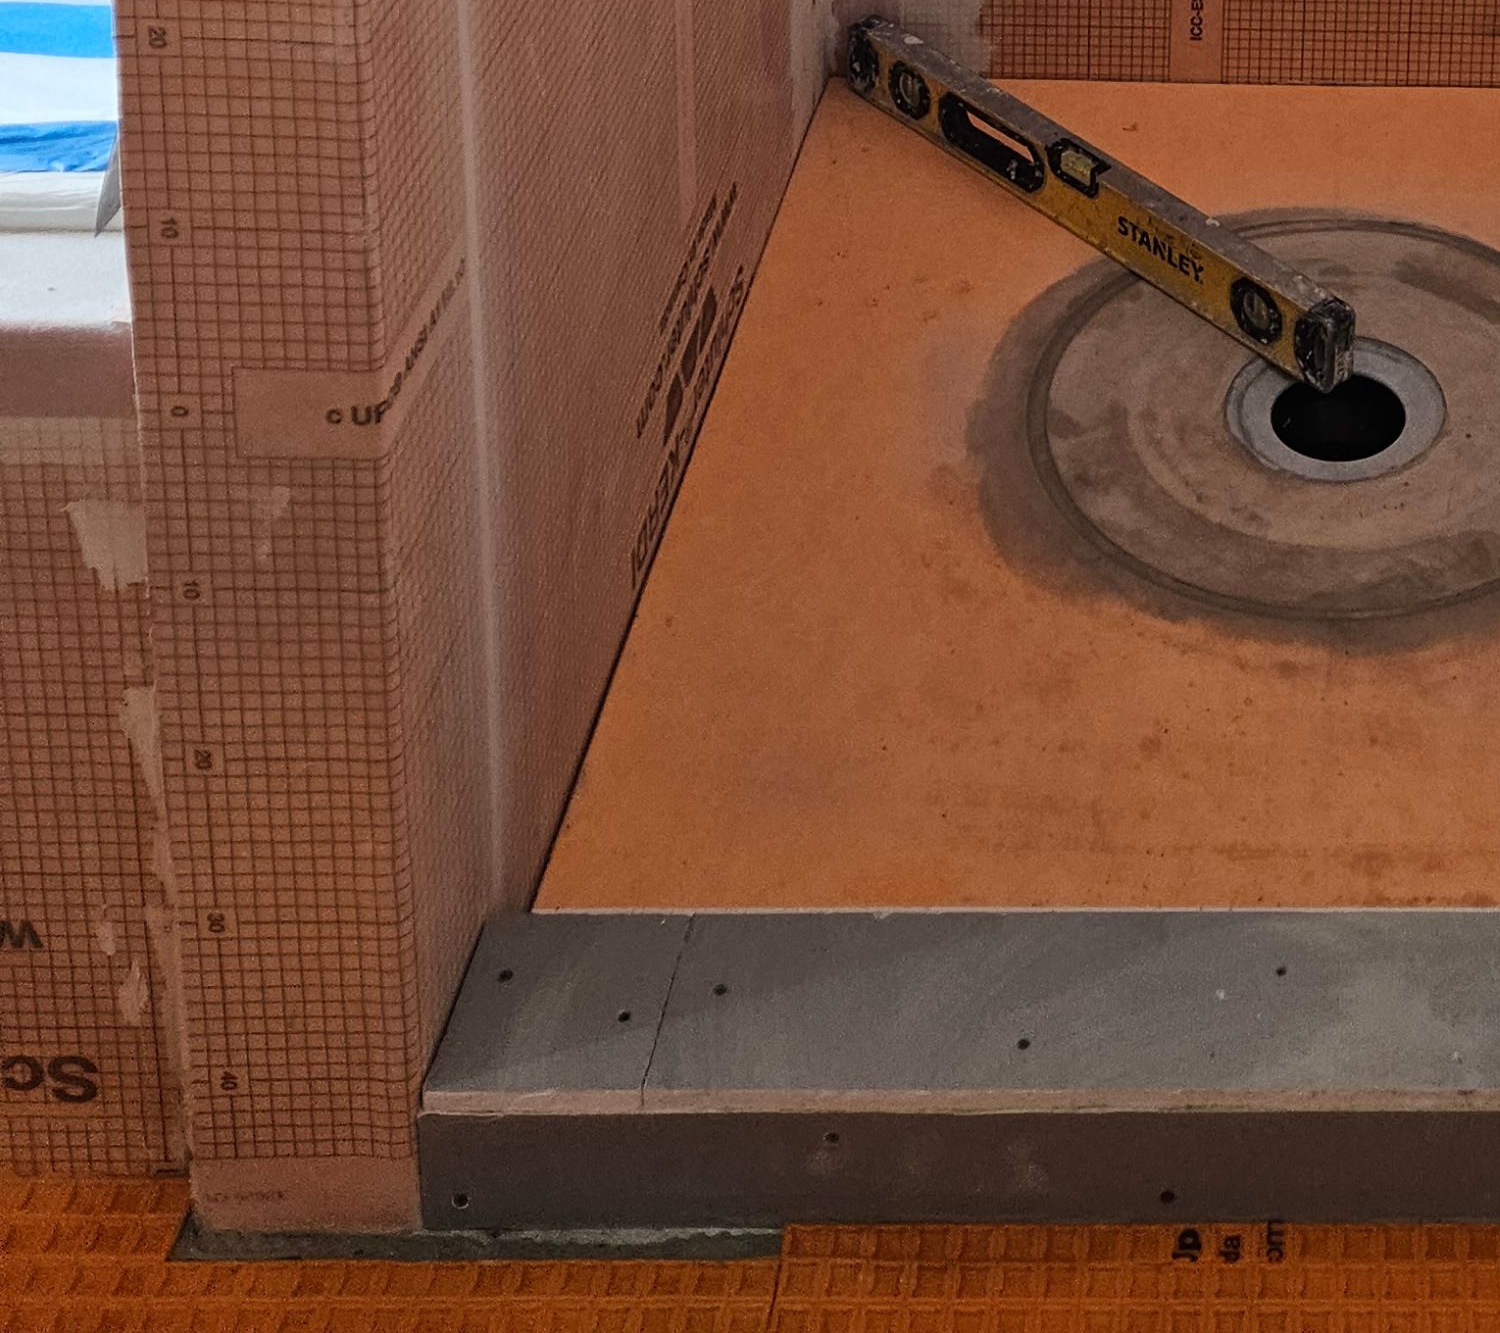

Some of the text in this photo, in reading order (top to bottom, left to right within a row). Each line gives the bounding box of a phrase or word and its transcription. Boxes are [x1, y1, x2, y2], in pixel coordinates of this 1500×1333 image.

[147, 25, 168, 50] 20
[161, 217, 179, 239] 10
[1117, 215, 1206, 286] STANLEY
[170, 405, 188, 417] 0
[182, 579, 200, 600] 10
[194, 749, 213, 769] 20
[207, 912, 225, 933] 30
[220, 1071, 238, 1091] 40
